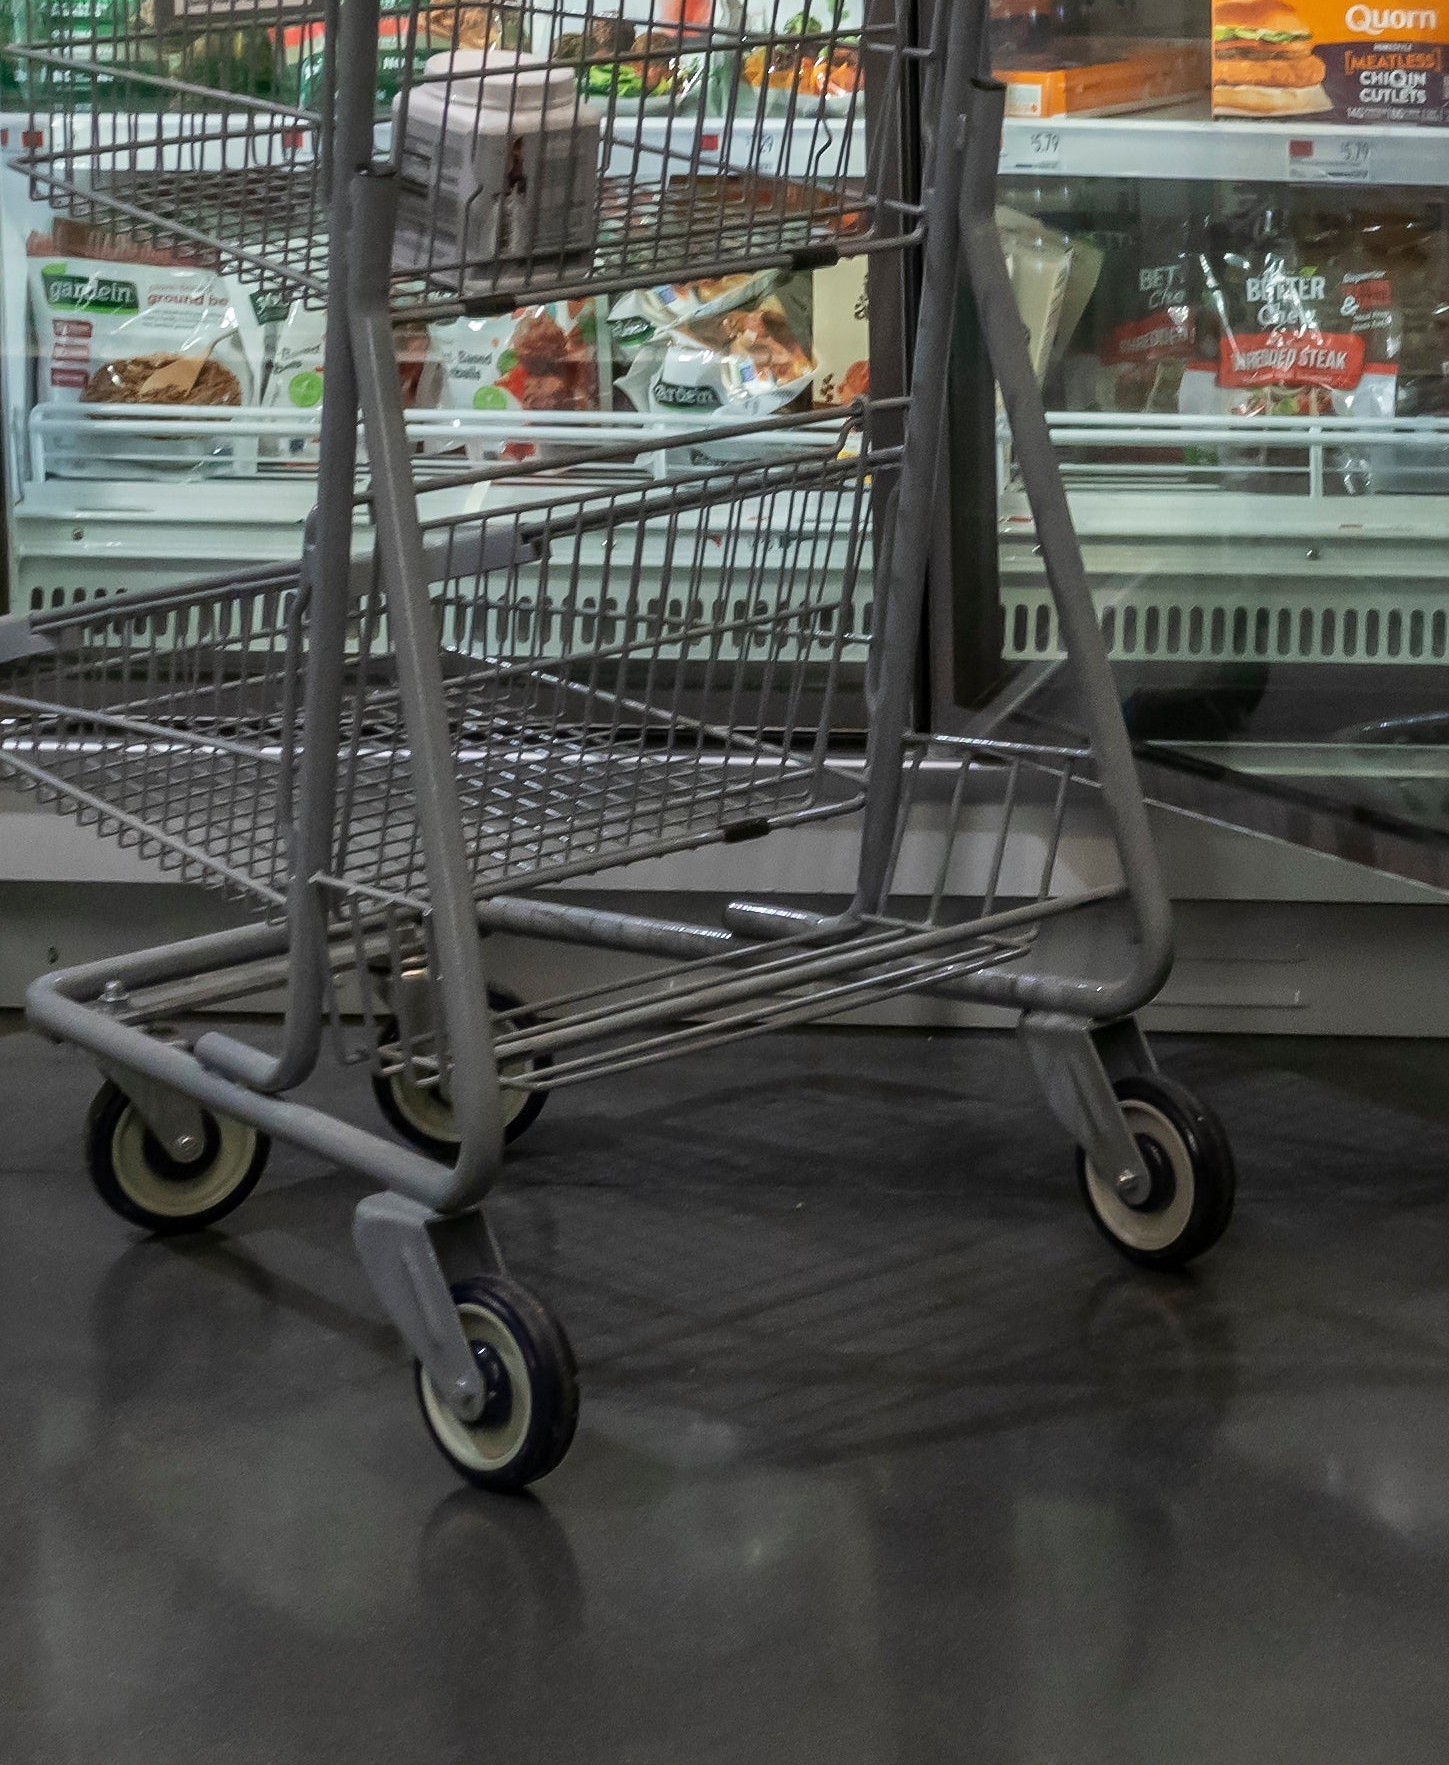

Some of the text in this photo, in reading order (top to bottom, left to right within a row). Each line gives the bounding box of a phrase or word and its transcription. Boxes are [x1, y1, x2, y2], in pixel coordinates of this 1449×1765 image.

[1345, 3, 1438, 34] Quorn
[1360, 69, 1428, 88] CHIQIN
[1359, 89, 1427, 105] CUTLETS
[147, 291, 204, 308] ground
[1246, 276, 1326, 304] BETTER
[1298, 348, 1348, 370] STEAK
